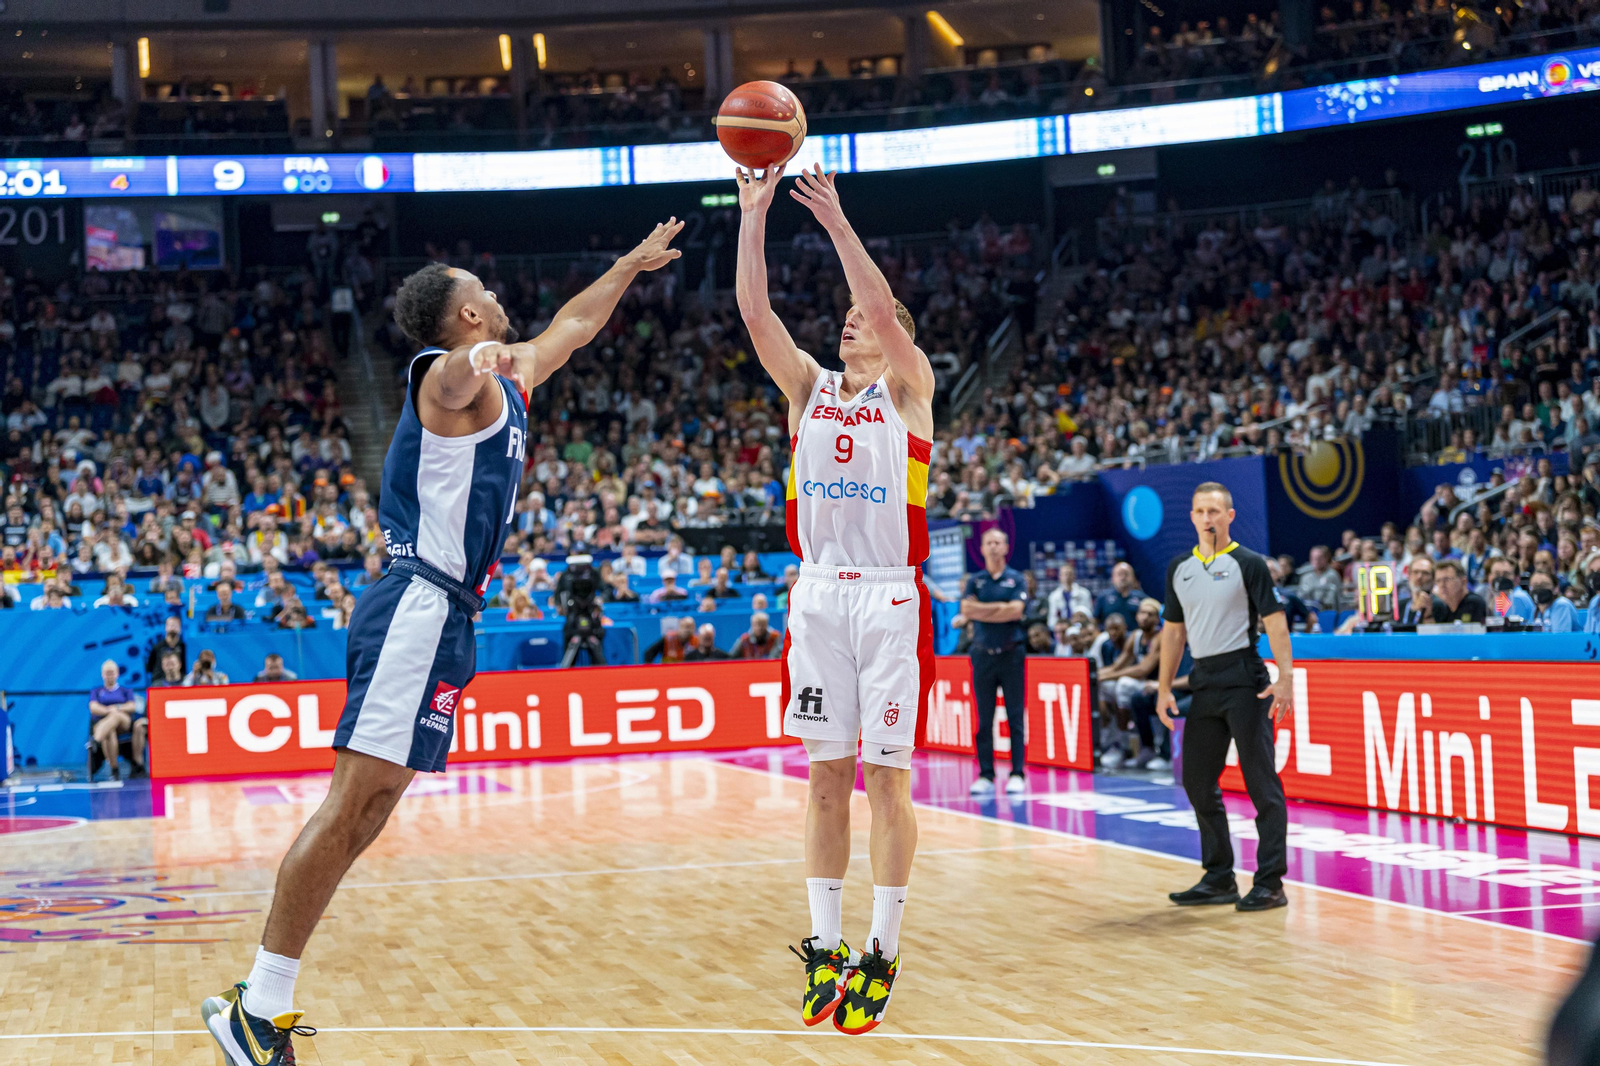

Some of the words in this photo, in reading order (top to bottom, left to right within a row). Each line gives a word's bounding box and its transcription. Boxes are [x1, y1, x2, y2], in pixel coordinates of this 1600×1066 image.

[213, 160, 245, 191] 9
[284, 157, 330, 173] FRA
[110, 174, 129, 191] 4
[0, 205, 65, 245] 201
[811, 404, 885, 428] ESPAÑA
[834, 434, 854, 464] 9
[803, 477, 887, 504] endesa
[838, 571, 862, 580] ESP
[165, 693, 338, 755] TCL
[568, 686, 716, 747] LED
[793, 712, 829, 723] network
[1037, 682, 1082, 763] TV
[1362, 691, 1496, 822] Mini
[1520, 696, 1600, 836] LE
